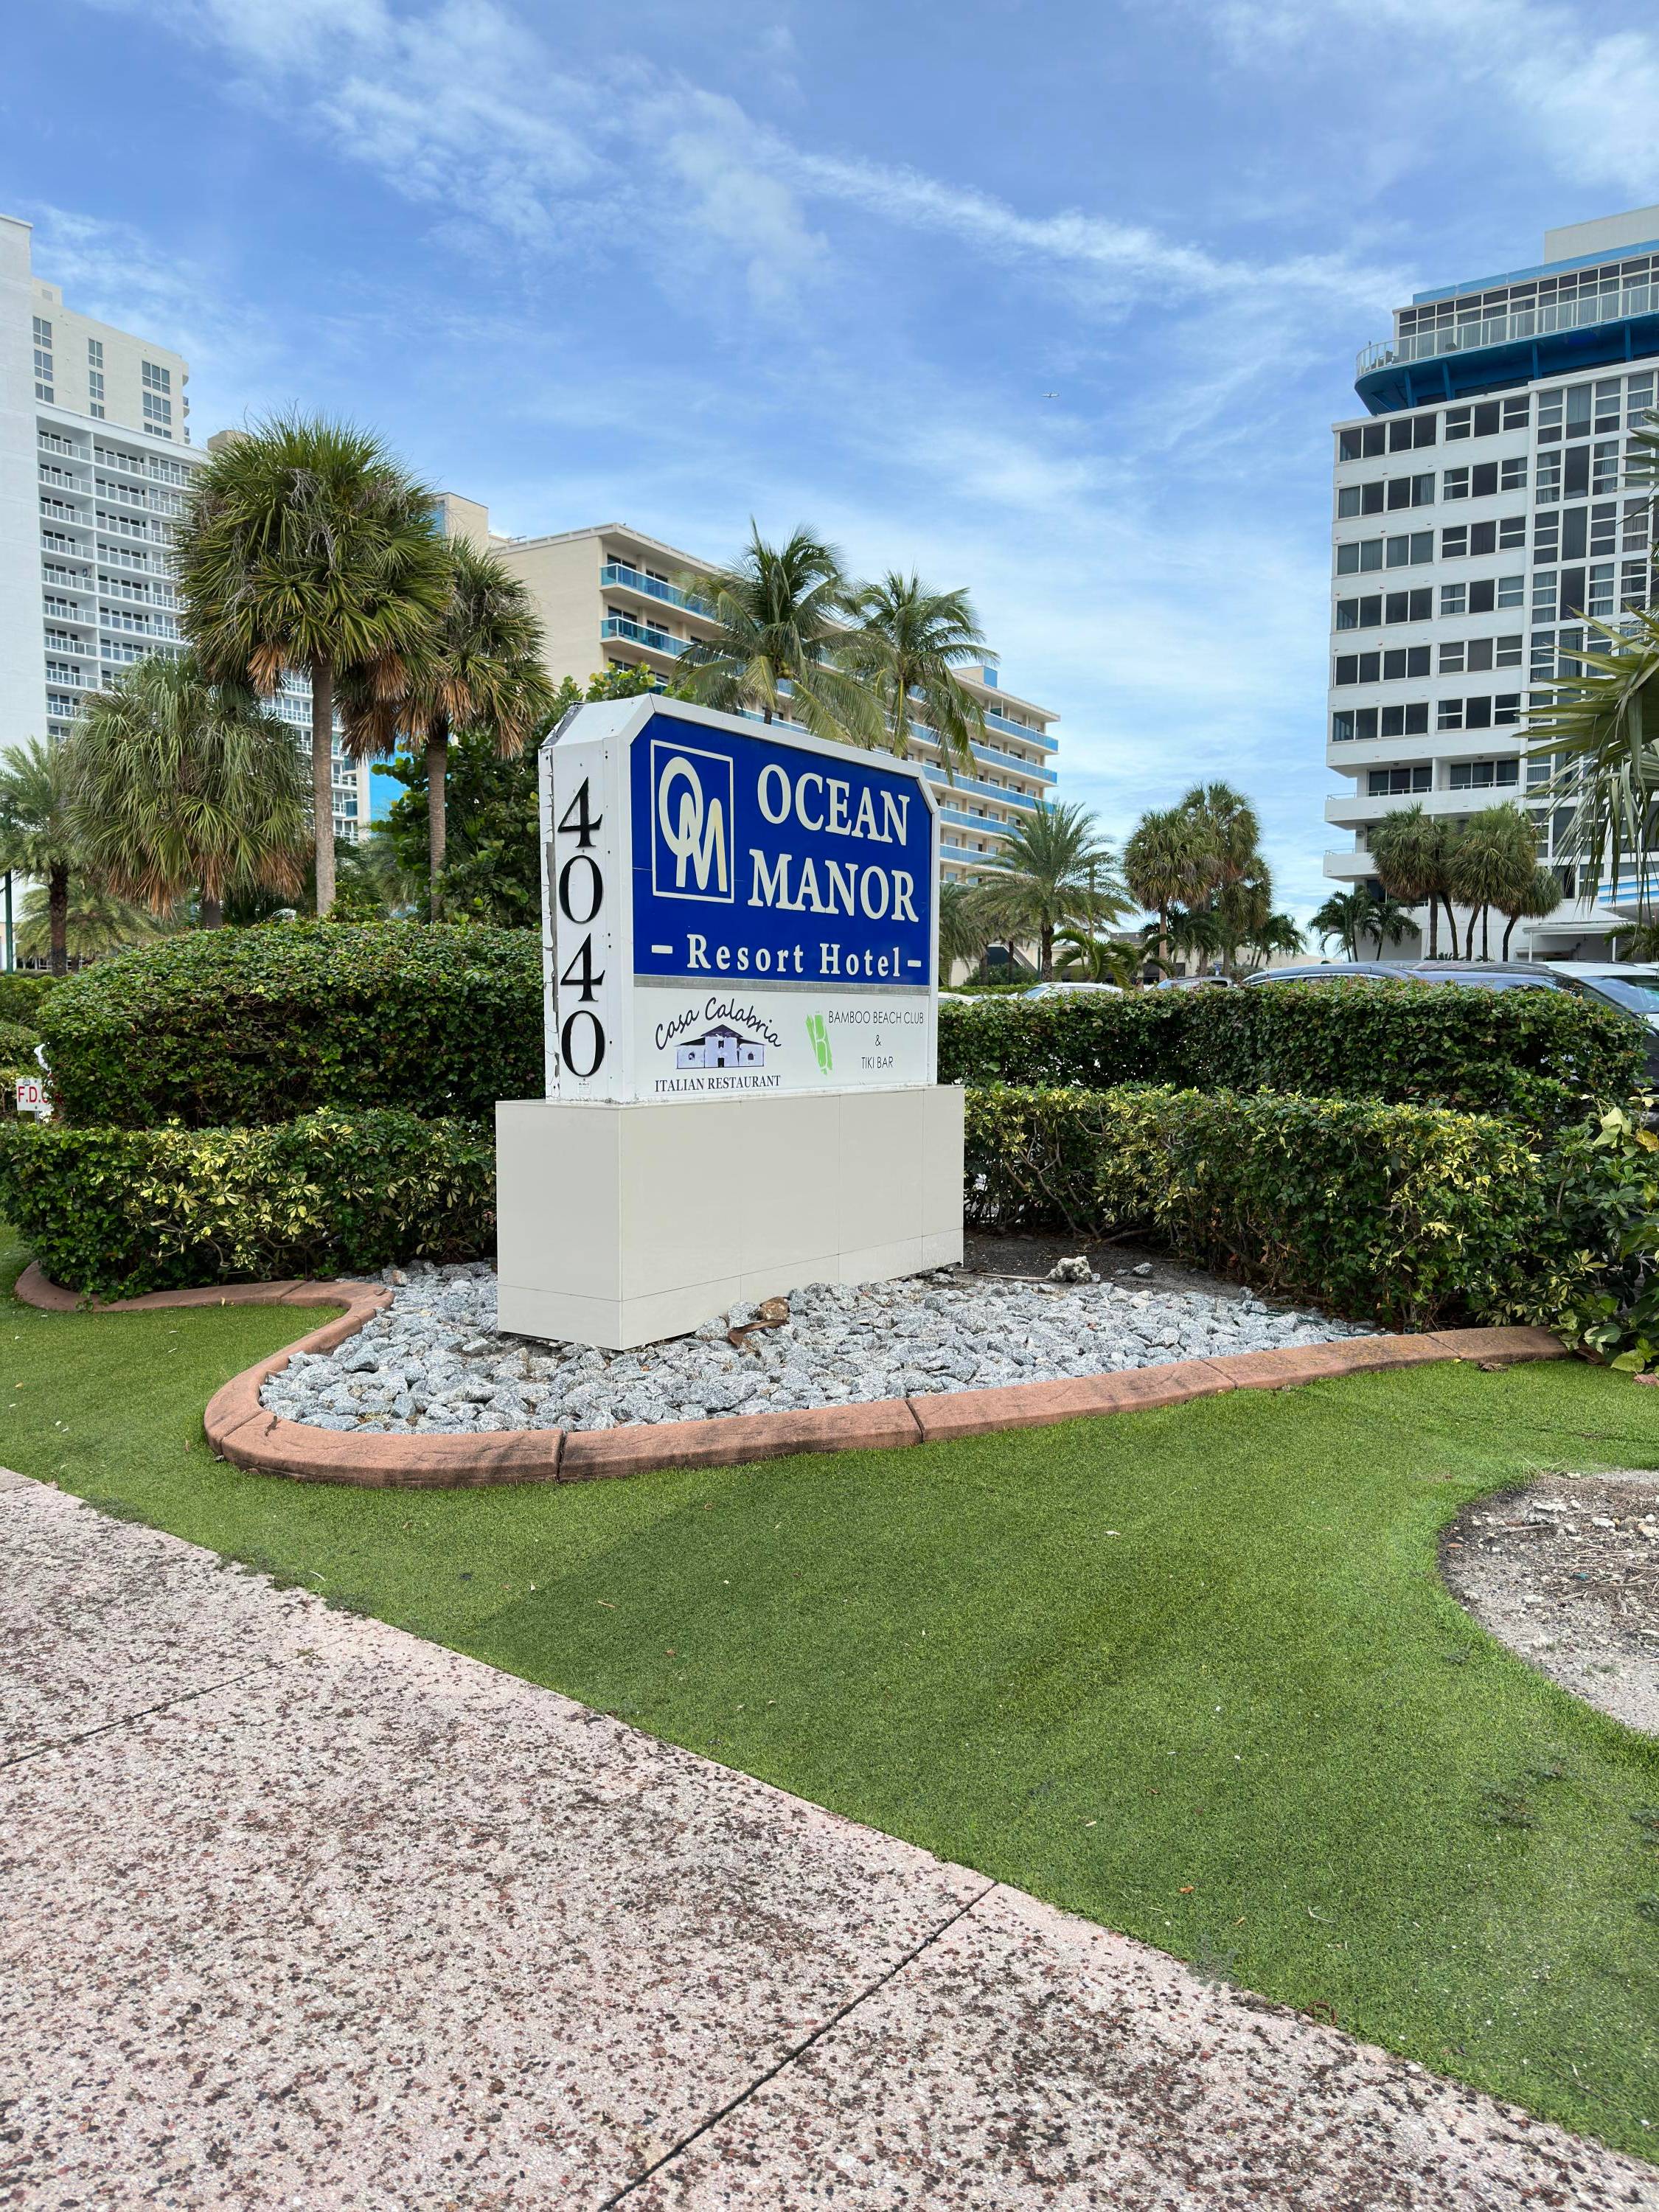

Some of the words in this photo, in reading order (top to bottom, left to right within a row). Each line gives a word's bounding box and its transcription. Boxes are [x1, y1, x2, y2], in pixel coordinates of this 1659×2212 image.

[757, 764, 911, 846] OCEAN
[747, 848, 919, 923] MANOR
[686, 933, 804, 973] Resort
[655, 1010, 700, 1051] Casa
[705, 997, 782, 1048] Calabria
[828, 1010, 871, 1024] BAMBOO
[873, 1011, 902, 1024] BEACH
[903, 1012, 924, 1024] CLUB
[874, 1034, 881, 1046] &
[861, 1057, 875, 1069] TIKI
[877, 1056, 894, 1068] BAR
[655, 1078, 705, 1093] ITALIAN
[708, 1075, 781, 1090] RESTAURANT
